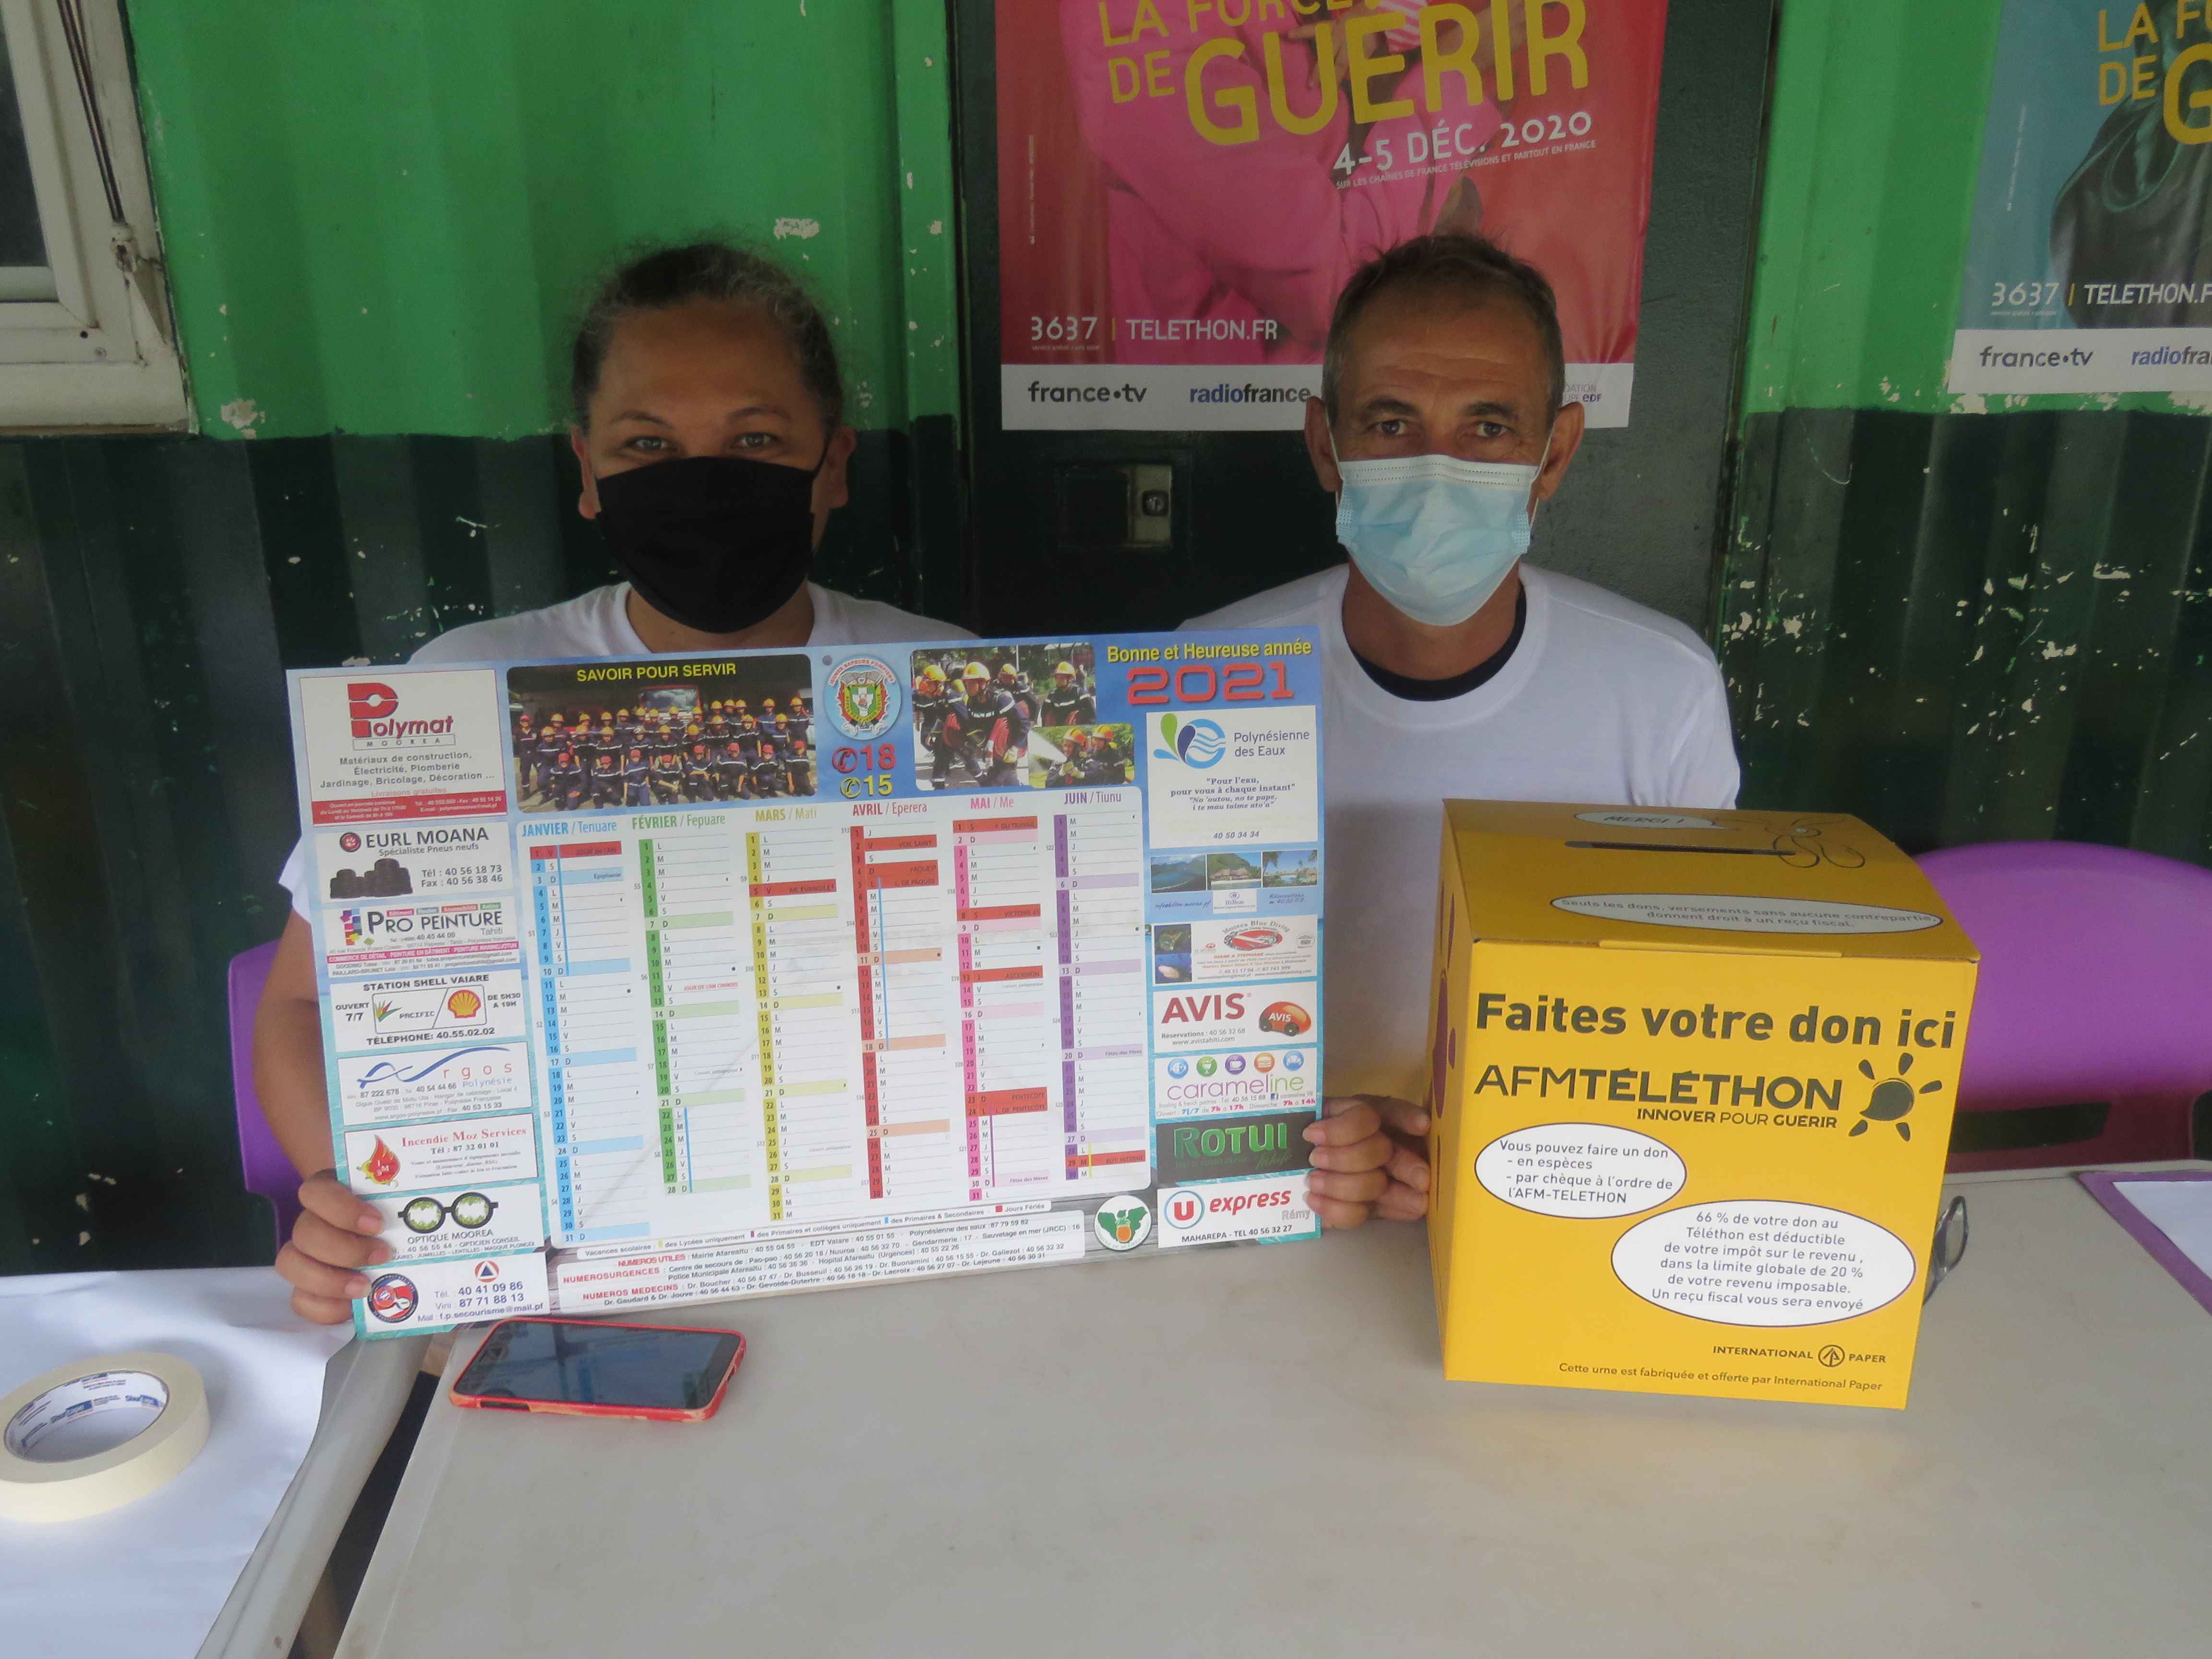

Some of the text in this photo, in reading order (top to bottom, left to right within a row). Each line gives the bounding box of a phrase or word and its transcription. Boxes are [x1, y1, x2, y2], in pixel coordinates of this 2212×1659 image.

[1099, 0, 1169, 47] LA
[2098, 2, 2159, 52] LA
[1108, 50, 1176, 104] DE
[2098, 54, 2158, 106] DE
[1333, 111, 1593, 174] 4-5 DÉC. 2020
[1336, 179, 1353, 189] SUR
[1353, 176, 1368, 186] LES
[1404, 168, 1416, 178] DE
[1417, 163, 1448, 176] FRANCE
[1501, 153, 1512, 162] ET
[1513, 147, 1550, 160] PARTOUT
[1551, 144, 1563, 155] EN
[1564, 140, 1597, 153] FRANCE
[1991, 282, 2212, 307] 3637 TELETHON.F
[1031, 316, 1278, 340] 3637 TELETHON.FR
[2131, 345, 2212, 366] radiofra
[1190, 384, 1311, 404] radiofrance
[1107, 638, 1311, 662] Bonne et Heureuse année
[577, 663, 736, 682] SAVOIR POUR SERVIR
[1127, 661, 1294, 705] 2021
[1234, 730, 1310, 745] Polynésienne
[339, 756, 388, 765] Matériaux
[406, 751, 472, 761] construction,
[860, 743, 896, 770] 18
[1235, 745, 1286, 757] des Eaux
[320, 772, 482, 788] Jardinage, Bricolage, Décoration
[864, 774, 893, 796] 15
[971, 796, 1013, 809] MAI Me
[1064, 791, 1121, 805] JUIN Tiunu
[755, 807, 818, 822] MARS Mati
[853, 802, 927, 817] AVRIL Eperera
[522, 821, 617, 837] JANVIER Tenuare
[632, 814, 725, 830] FÉVRIER Fepuare
[366, 827, 489, 848] EURL MOANA
[367, 911, 503, 934] PRO PEINTURE
[363, 974, 489, 991] STATION SHELL VAIARE
[1161, 993, 1245, 1023] AVIS
[1268, 1013, 1291, 1023] AVIS
[1477, 992, 1956, 1048] Faites votre don ici
[366, 1027, 495, 1046] TÉLÉPHONE: 40.55.02.02
[1167, 1073, 1306, 1100] carameline
[1474, 1065, 1842, 1111] AFMTÉLÉTHON
[1637, 1108, 1837, 1128] INNOVER POUR GUÉRIR
[402, 1128, 527, 1147] Incendie Moz Services
[1174, 1122, 1288, 1158] ROTUI
[1500, 1140, 1669, 1158] Vous pouvez faire un don
[1517, 1157, 1592, 1170] en espèces
[1516, 1173, 1673, 1190] par chèque à l'ordre de
[1509, 1187, 1626, 1203] l'AFM-TELETHON
[1174, 1190, 1291, 1221] U express
[1696, 1211, 1838, 1229] 66 % de votre don au
[407, 1229, 493, 1244] OPTIQUE MOOREA
[1686, 1226, 1845, 1245] Téléthon est déductible
[1664, 1242, 1856, 1262] de votre impôt sur le revenu
[1660, 1258, 1863, 1278] dans la limite globale de 20 %
[1668, 1274, 1851, 1293] de votre revenu imposable.
[1652, 1288, 1863, 1311] Un reçu fiscal vous sera envoyé
[1713, 1346, 1887, 1363] INTERNATIONAL PAPER
[1559, 1362, 1589, 1373] Cette
[1621, 1368, 1637, 1376] est
[1640, 1367, 1695, 1380] fabriquée
[1711, 1371, 1749, 1382] offerte
[1752, 1377, 1771, 1385] par
[1774, 1376, 1846, 1388] International
[1849, 1380, 1883, 1392] Paper
